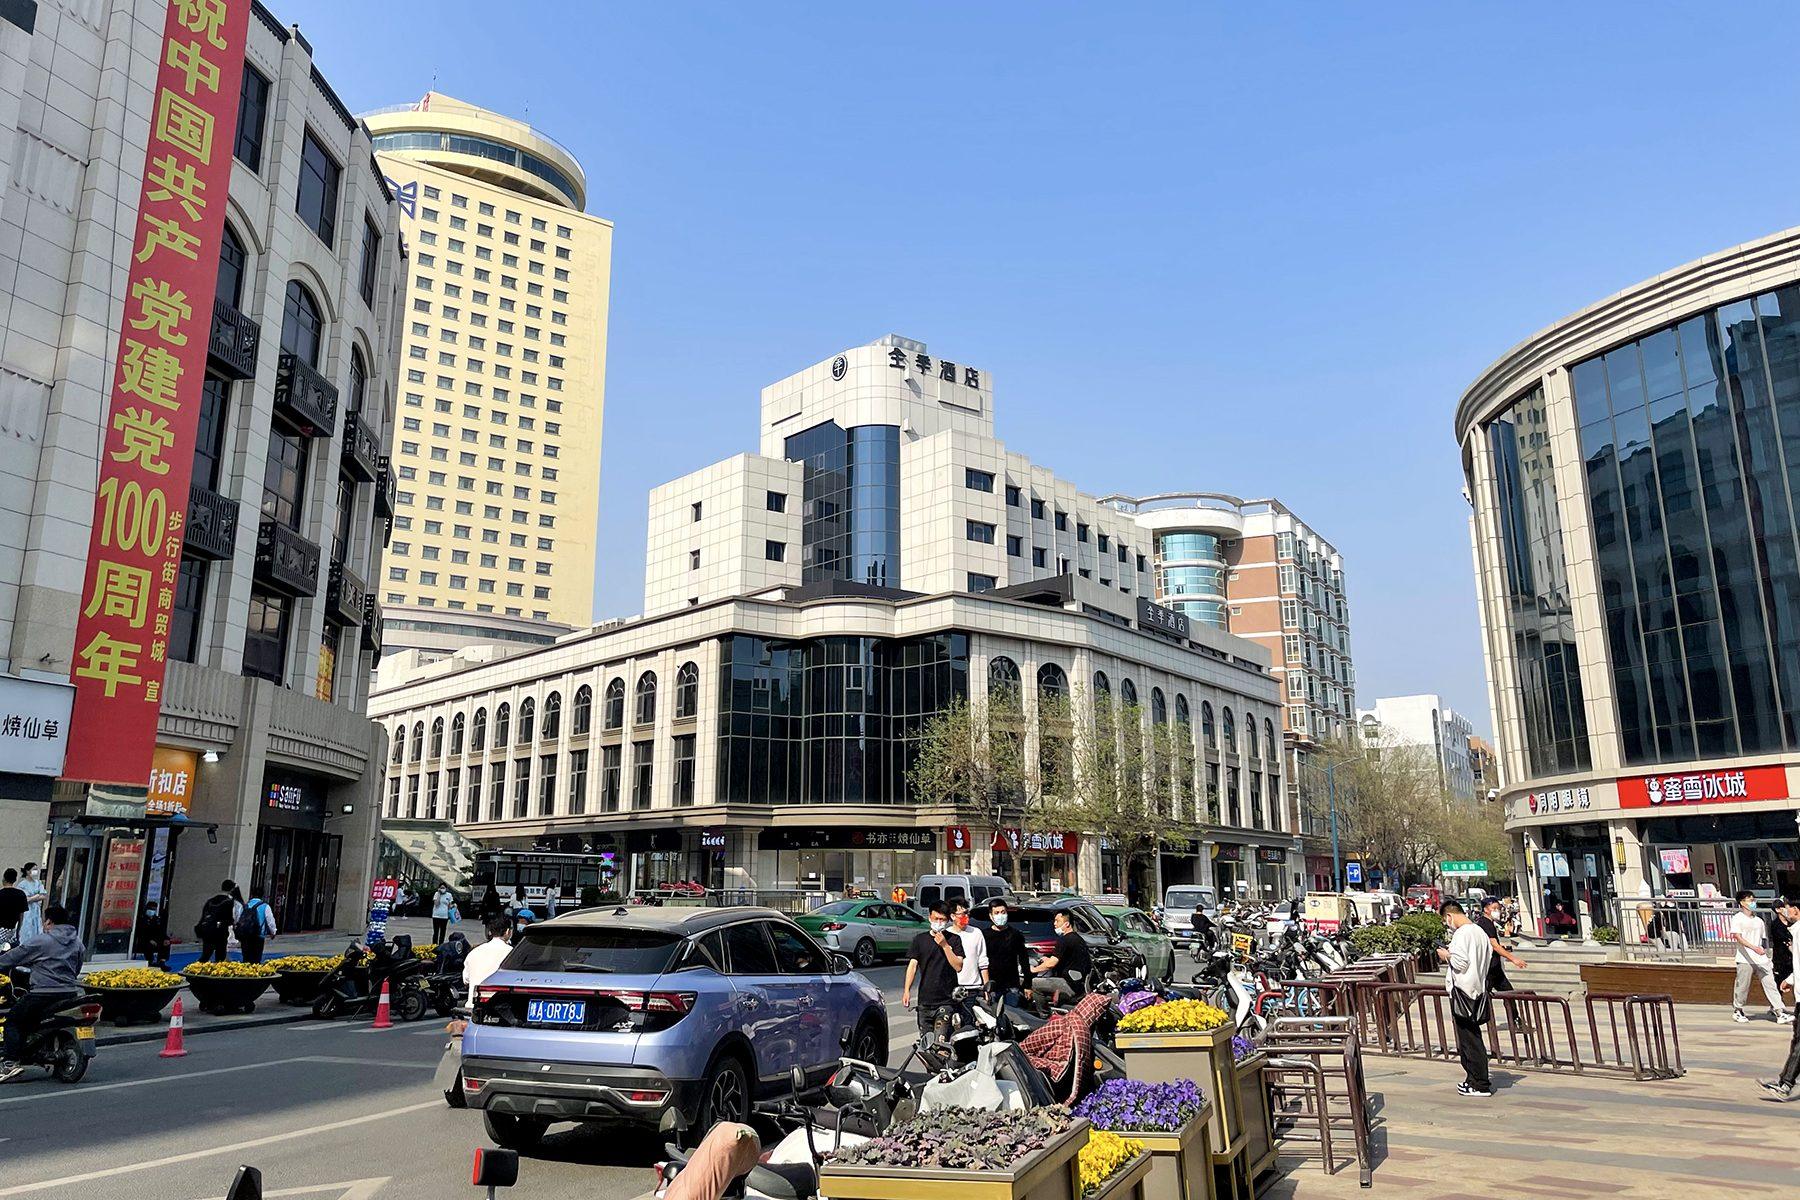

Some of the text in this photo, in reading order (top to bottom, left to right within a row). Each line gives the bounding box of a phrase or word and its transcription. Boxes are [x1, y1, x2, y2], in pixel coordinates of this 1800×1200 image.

[888, 347, 980, 390] 全季酒店
[1146, 605, 1185, 633] 全季酒店
[1663, 771, 1748, 801] 蜜雪冰城
